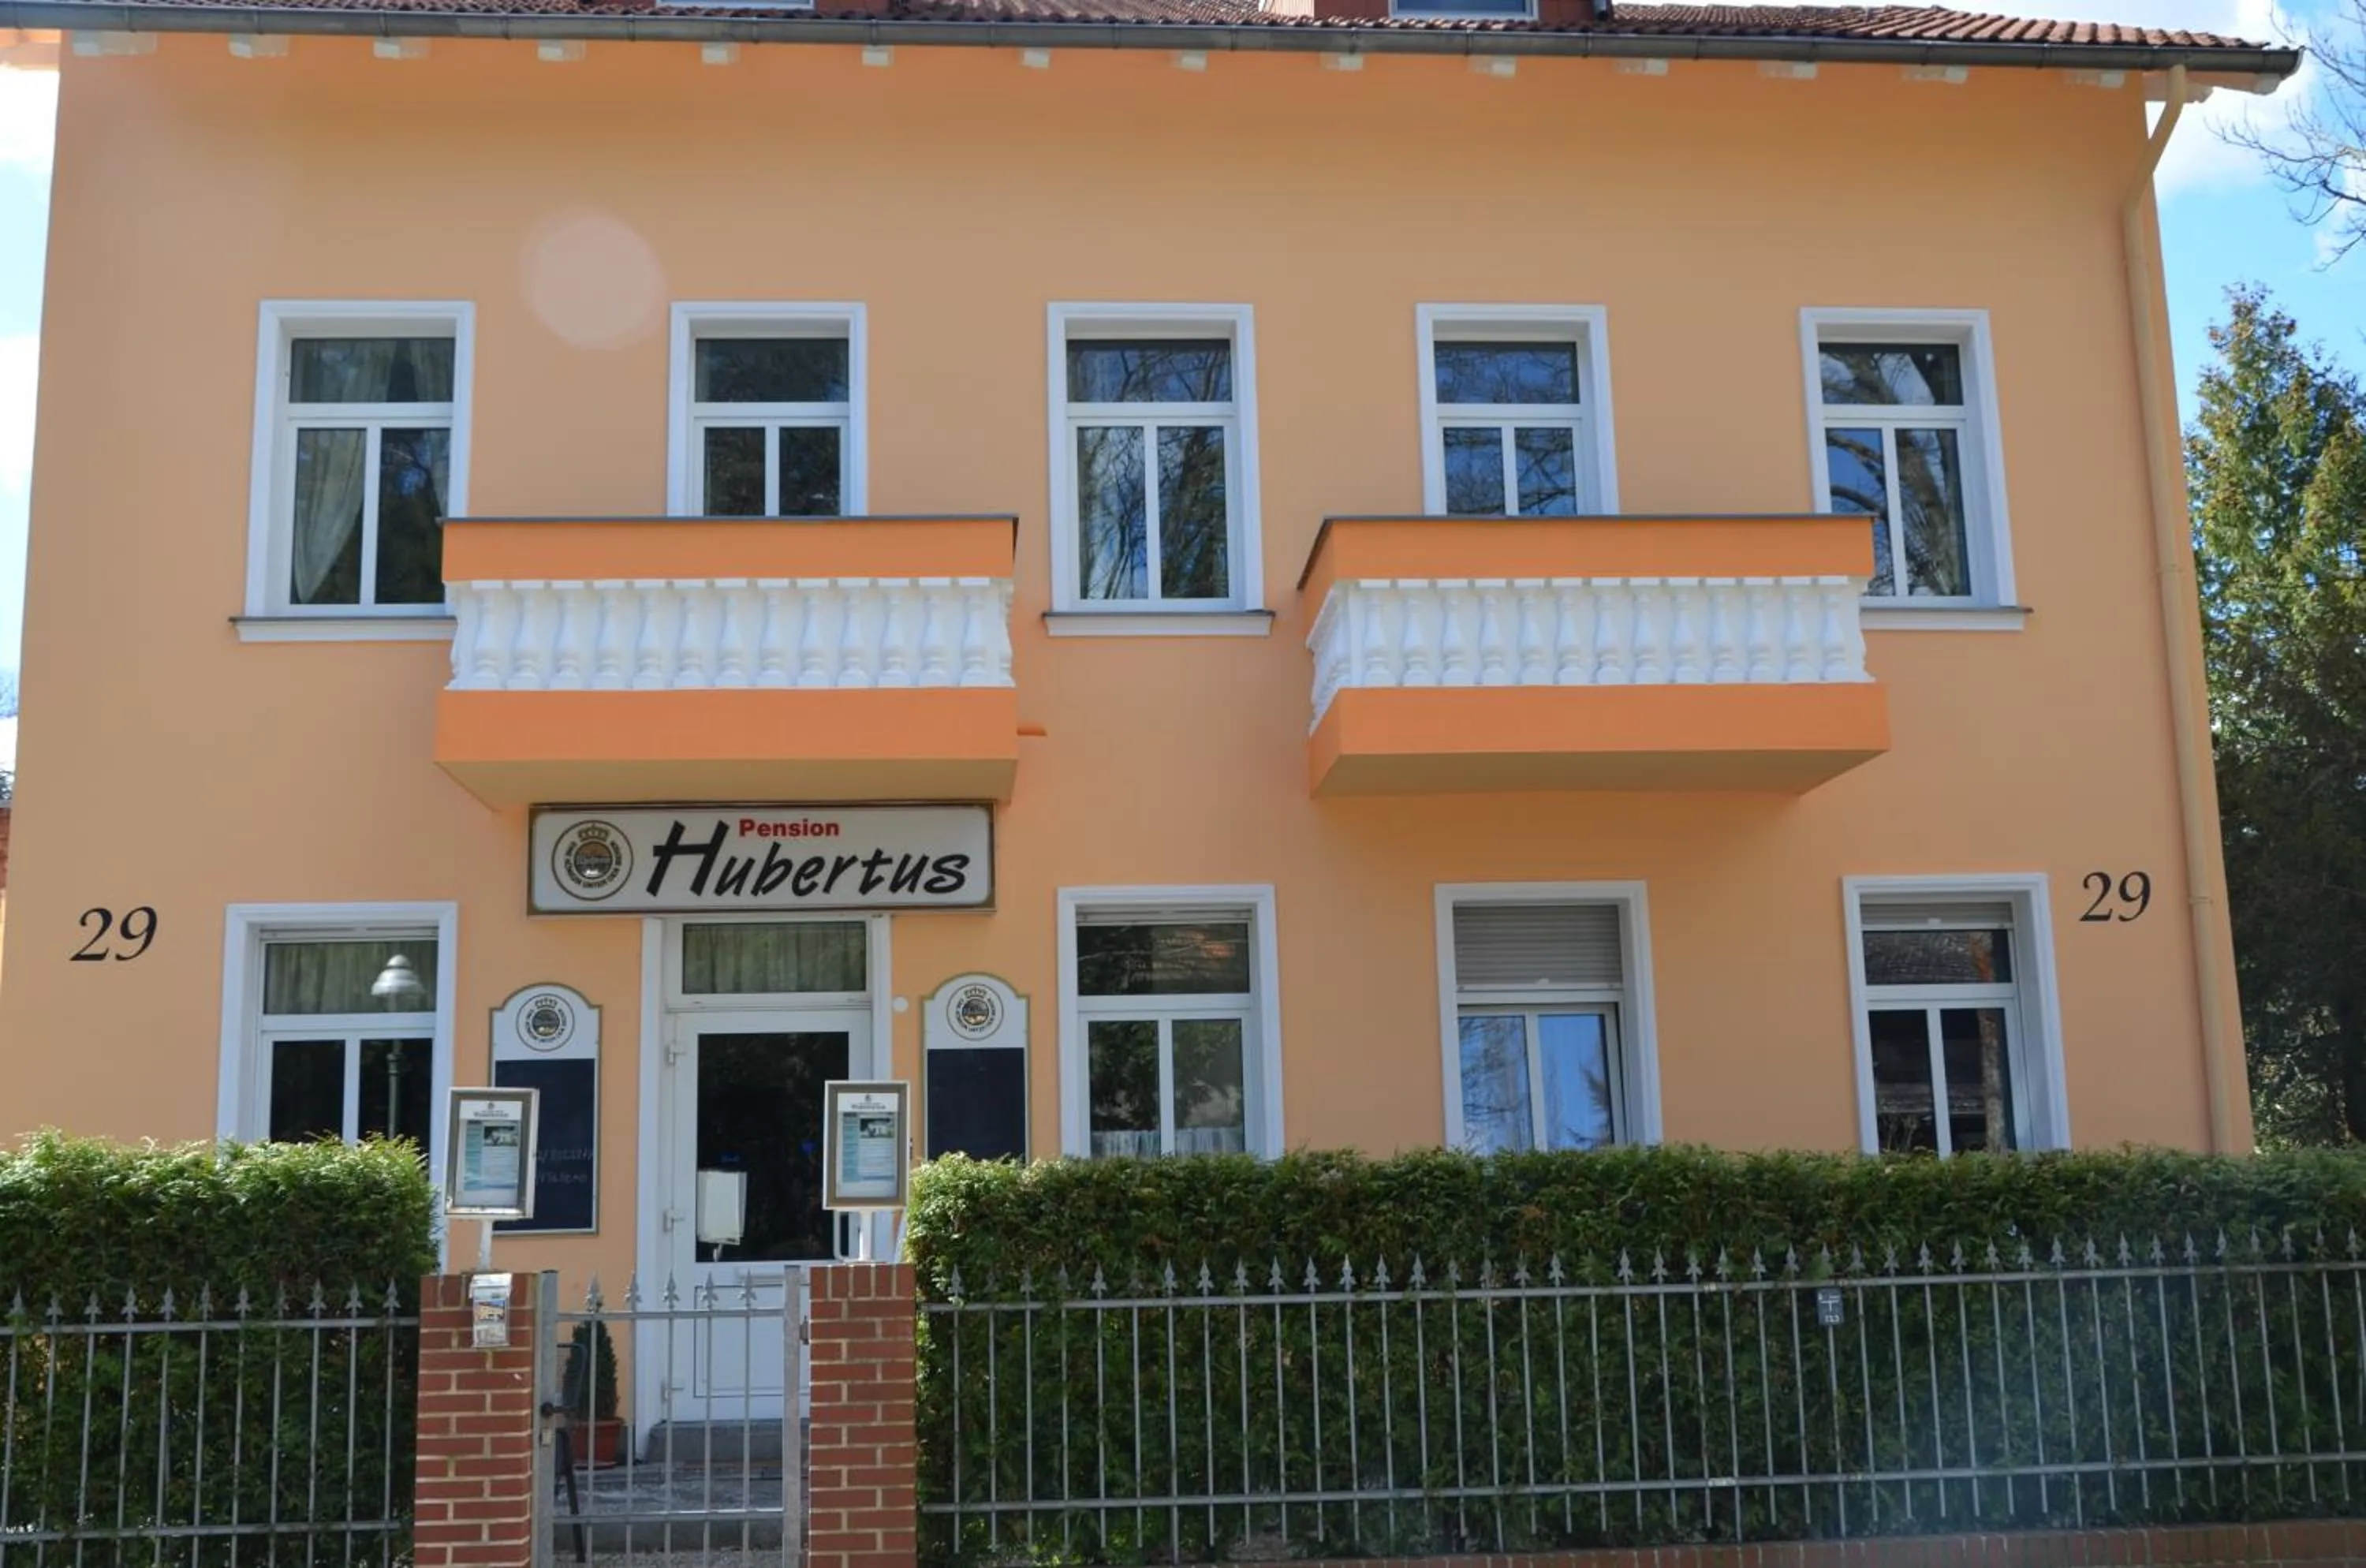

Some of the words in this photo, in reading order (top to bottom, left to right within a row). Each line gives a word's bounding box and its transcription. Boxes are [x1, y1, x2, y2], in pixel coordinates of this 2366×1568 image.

[738, 818, 840, 838] Pension
[645, 819, 971, 898] Hubertus
[2078, 871, 2151, 922] 29
[69, 905, 158, 961] 29
